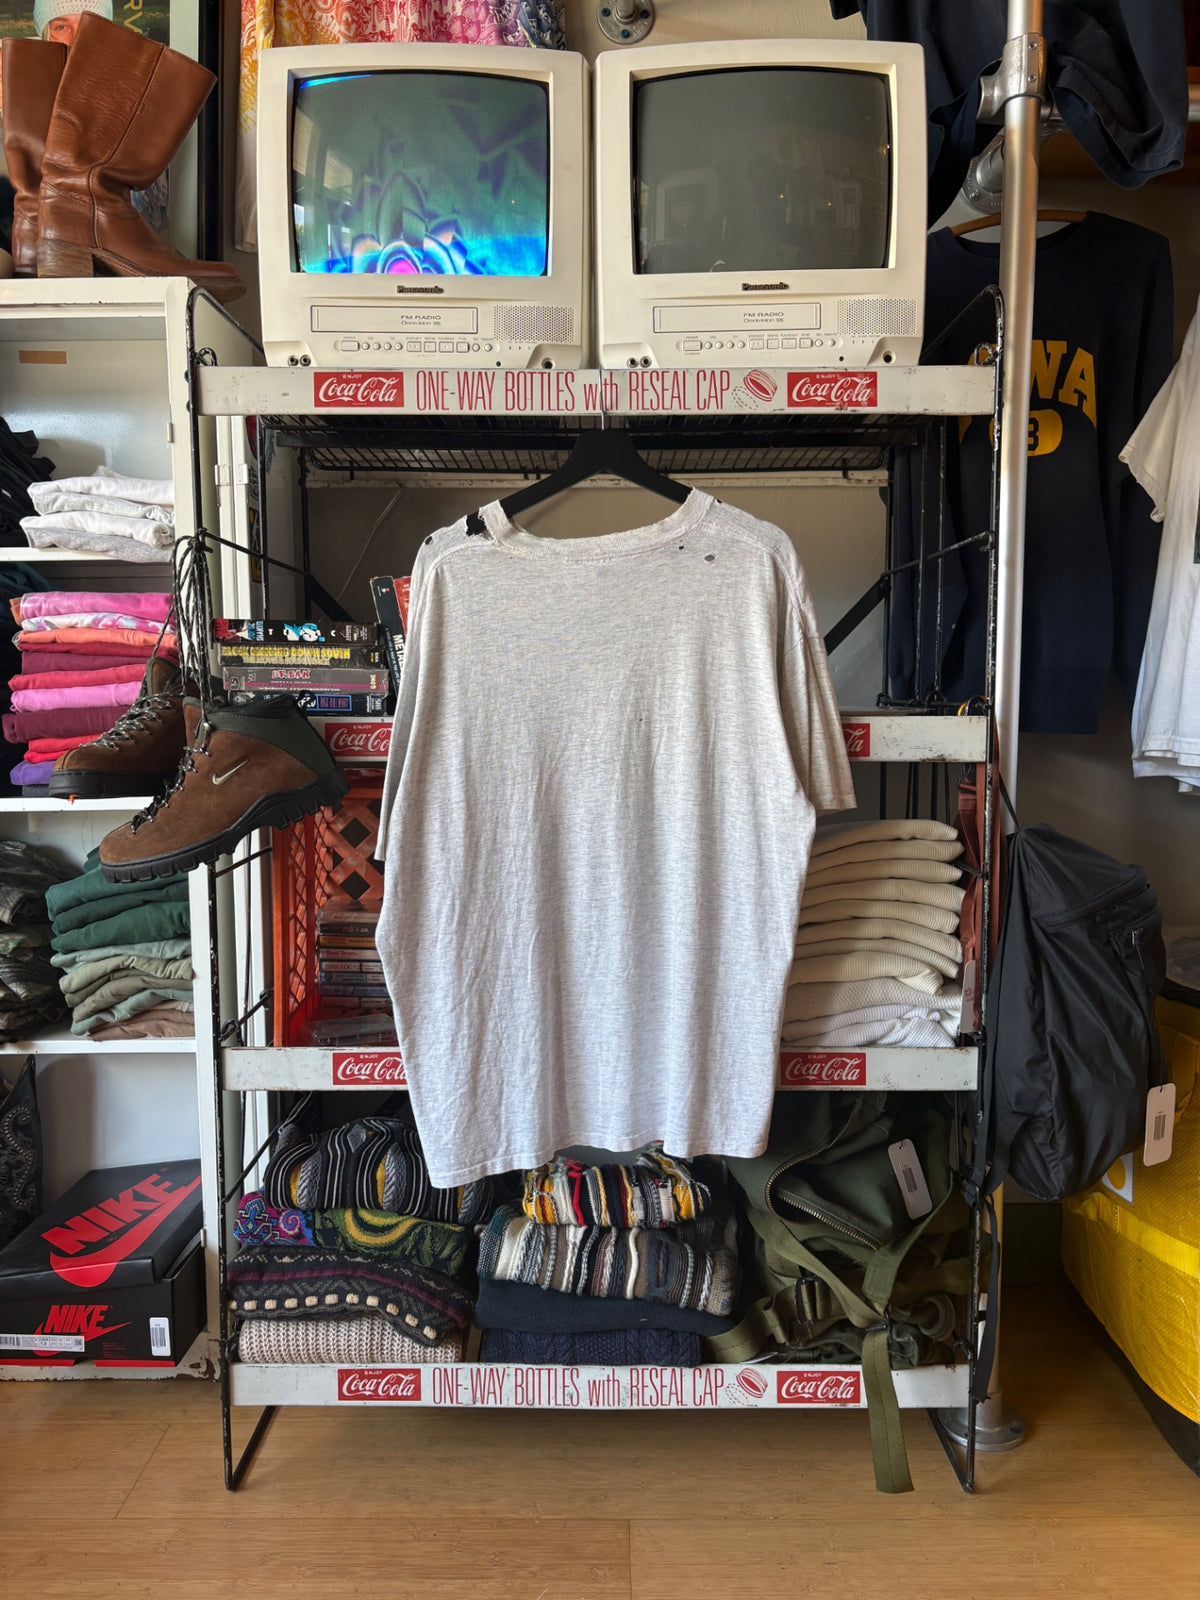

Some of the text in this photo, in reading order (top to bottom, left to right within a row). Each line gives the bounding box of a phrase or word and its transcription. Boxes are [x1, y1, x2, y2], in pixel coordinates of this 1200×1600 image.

[397, 285, 444, 294] Panasonic
[742, 282, 789, 291] Panasonic
[318, 377, 400, 403] Coca-Cola
[415, 369, 731, 412] ONE-WAY BOTTLES with RESEAL CAP
[791, 376, 874, 403] Coca-Cola
[329, 727, 392, 752] Coca-Co
[785, 1057, 864, 1081] Coca-Cola
[40, 1173, 186, 1255] NIKE
[43, 1304, 109, 1334] NIKE
[342, 1373, 418, 1397] Coca-Cola
[431, 1366, 724, 1407] ONE-WAY BOTTLES with RESEAL CAP
[781, 1375, 858, 1399] Coca-Cola
